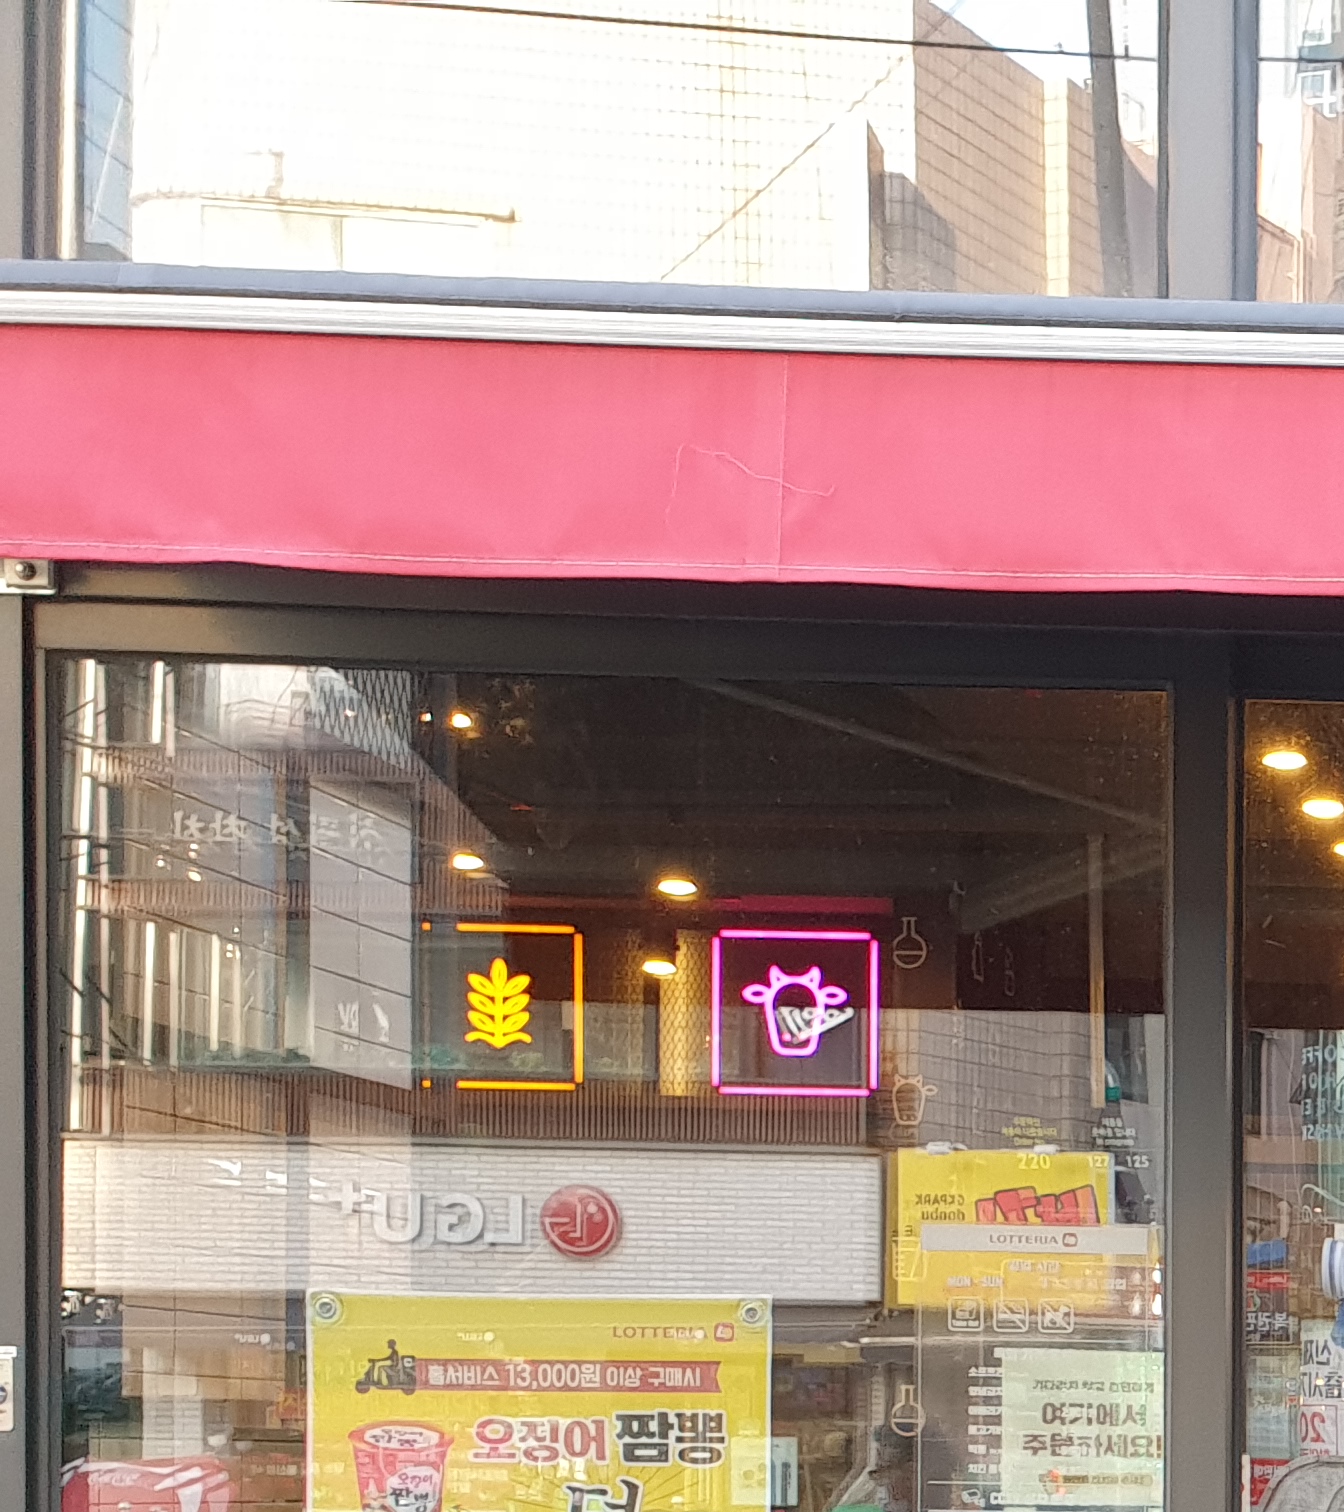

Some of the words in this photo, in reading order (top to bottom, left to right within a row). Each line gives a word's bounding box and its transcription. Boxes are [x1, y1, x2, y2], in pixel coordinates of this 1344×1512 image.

[506, 1363, 601, 1389] 13,000원
[606, 1366, 642, 1386] 이상
[647, 1366, 701, 1388] 구매시
[474, 1417, 607, 1463] 오징어
[615, 1410, 727, 1466] 짬뽕
